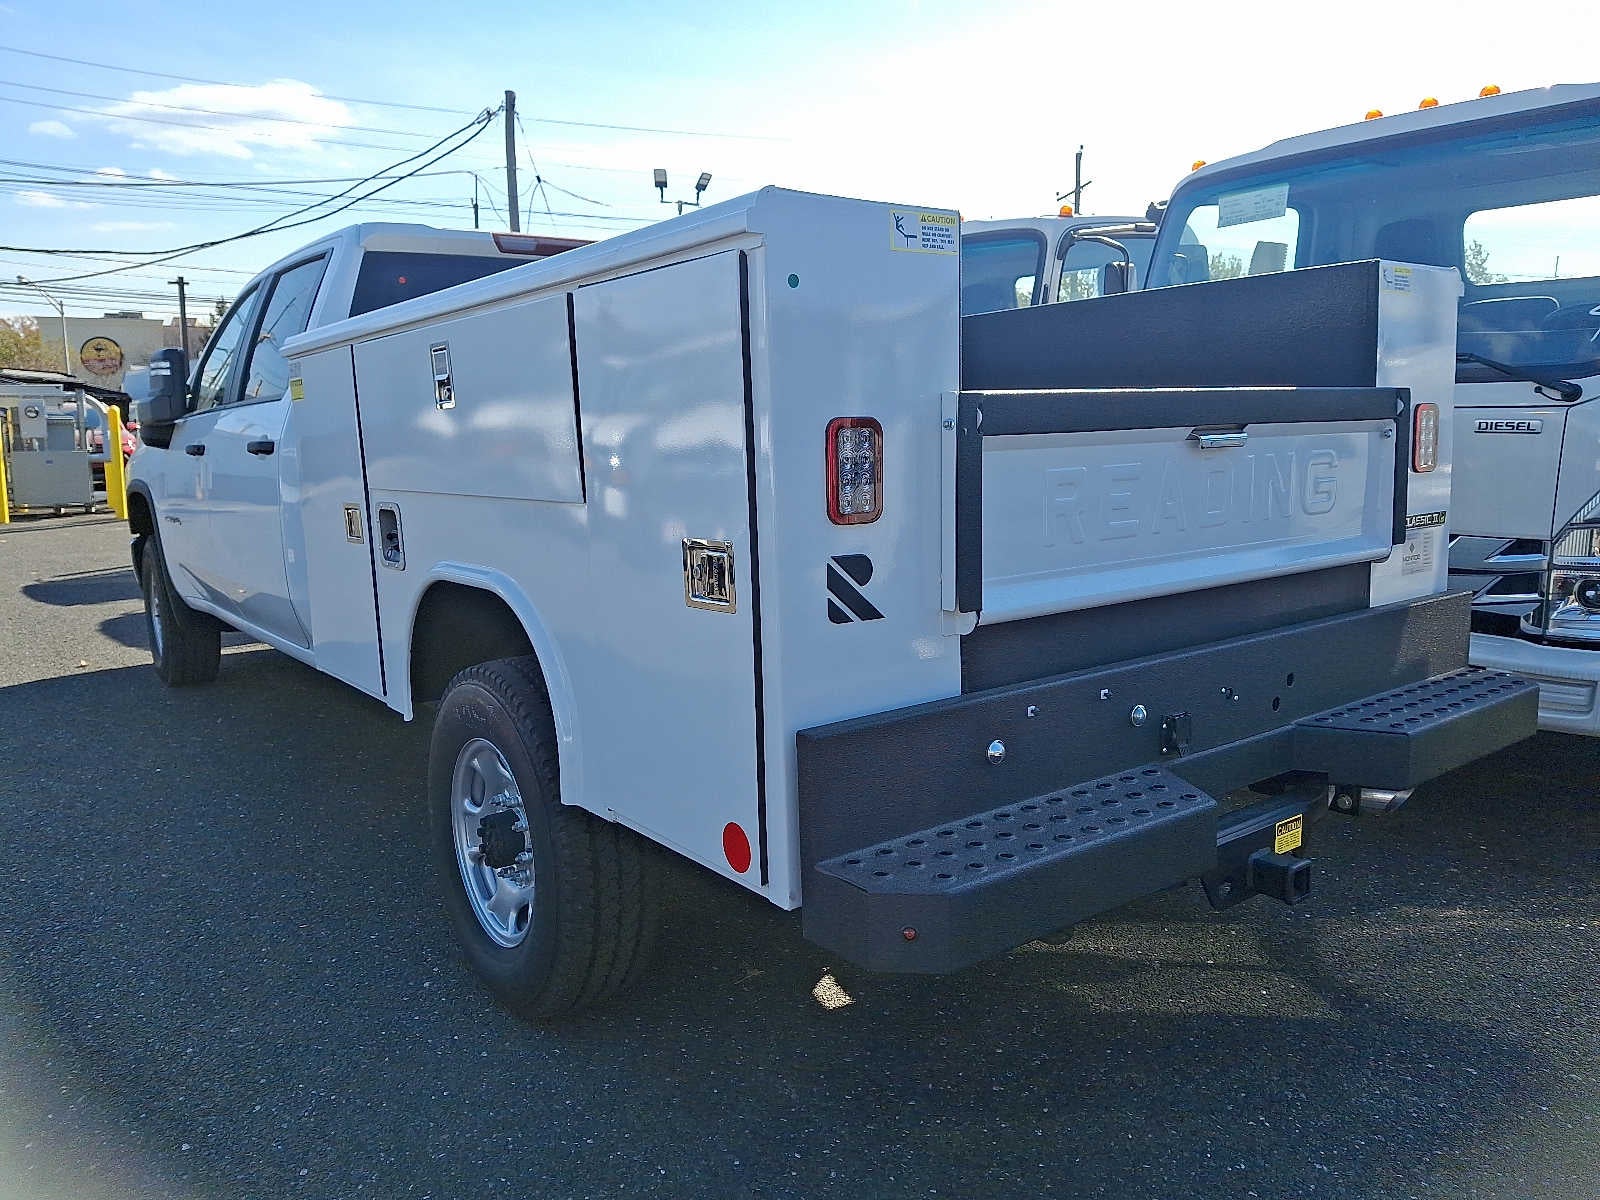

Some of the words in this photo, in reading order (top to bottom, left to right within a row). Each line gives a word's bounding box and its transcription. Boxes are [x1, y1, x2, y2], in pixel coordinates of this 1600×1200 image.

[927, 215, 956, 225] CAUTION
[1477, 421, 1537, 431] DIESEL
[1042, 449, 1338, 548] READING
[1277, 819, 1301, 836] CAUTION
